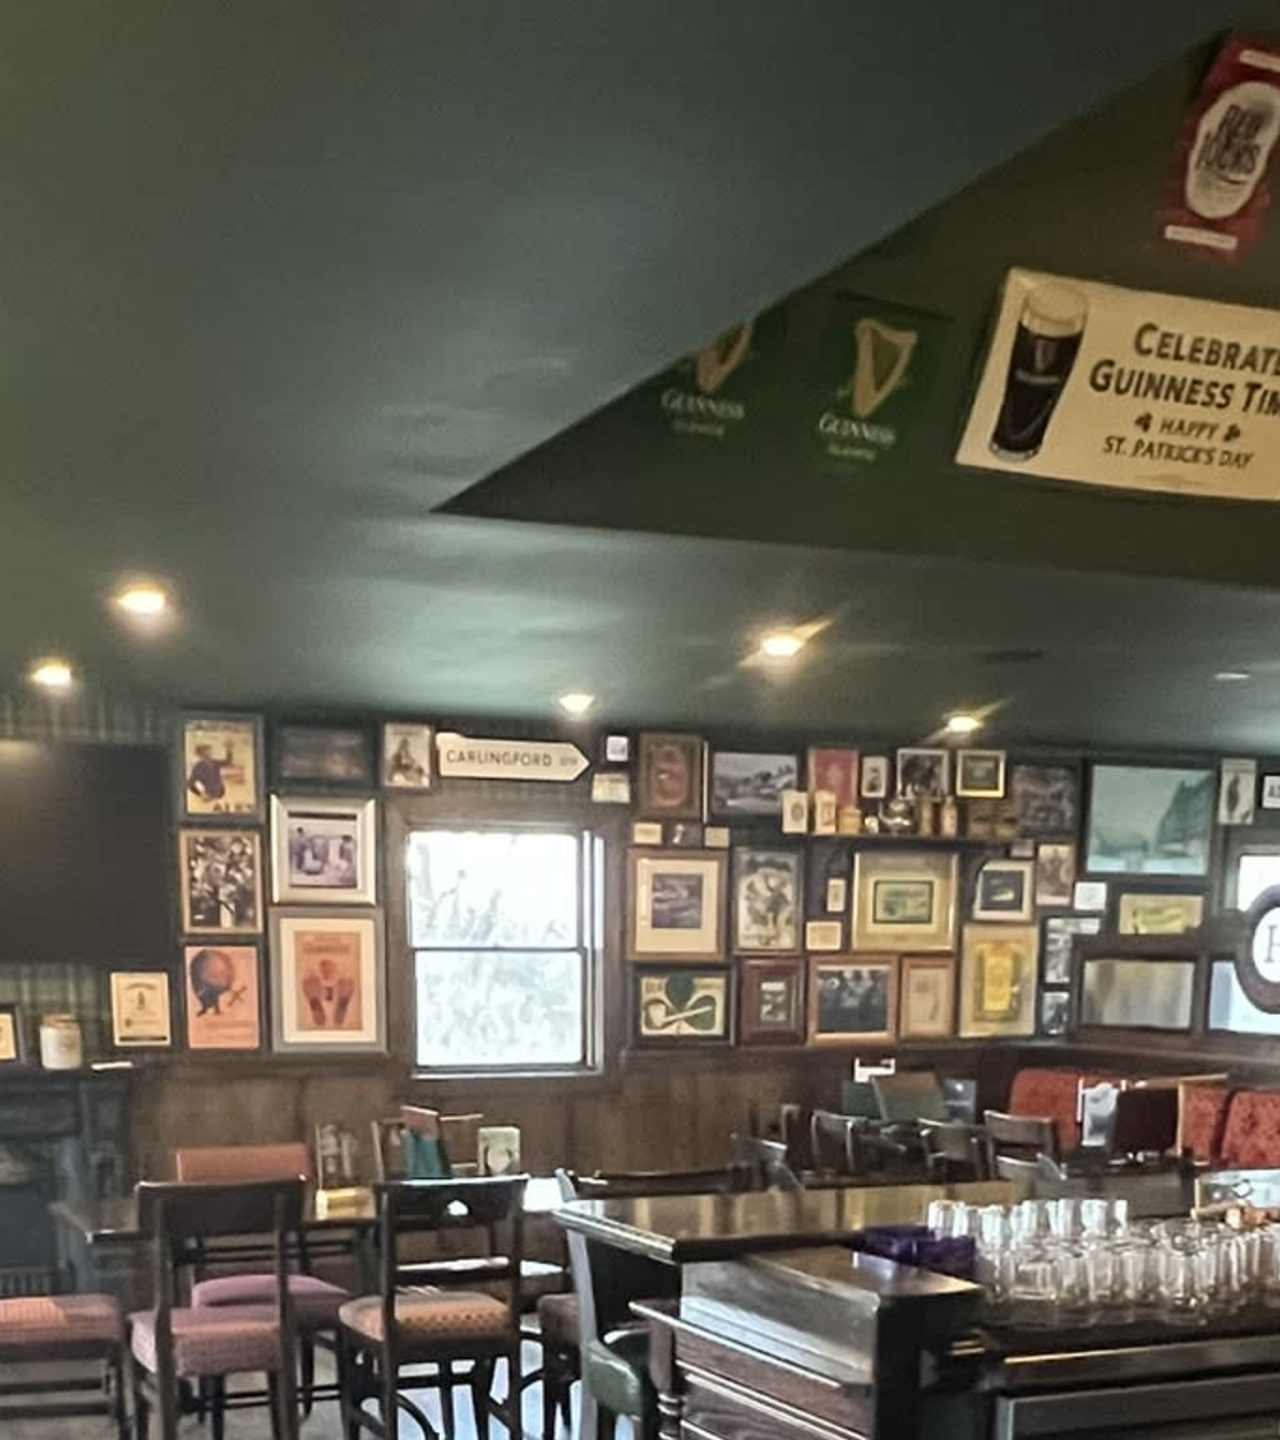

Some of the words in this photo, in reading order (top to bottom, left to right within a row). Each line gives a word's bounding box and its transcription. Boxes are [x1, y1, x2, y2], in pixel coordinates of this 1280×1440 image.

[1088, 358, 1236, 411] GUINNESS
[819, 411, 896, 446] GUINNESS
[1158, 415, 1222, 443] HAPPY
[1132, 440, 1217, 466] PATRICK'S
[1220, 446, 1253, 470] DAY
[445, 748, 553, 768] CARLINGFORD
